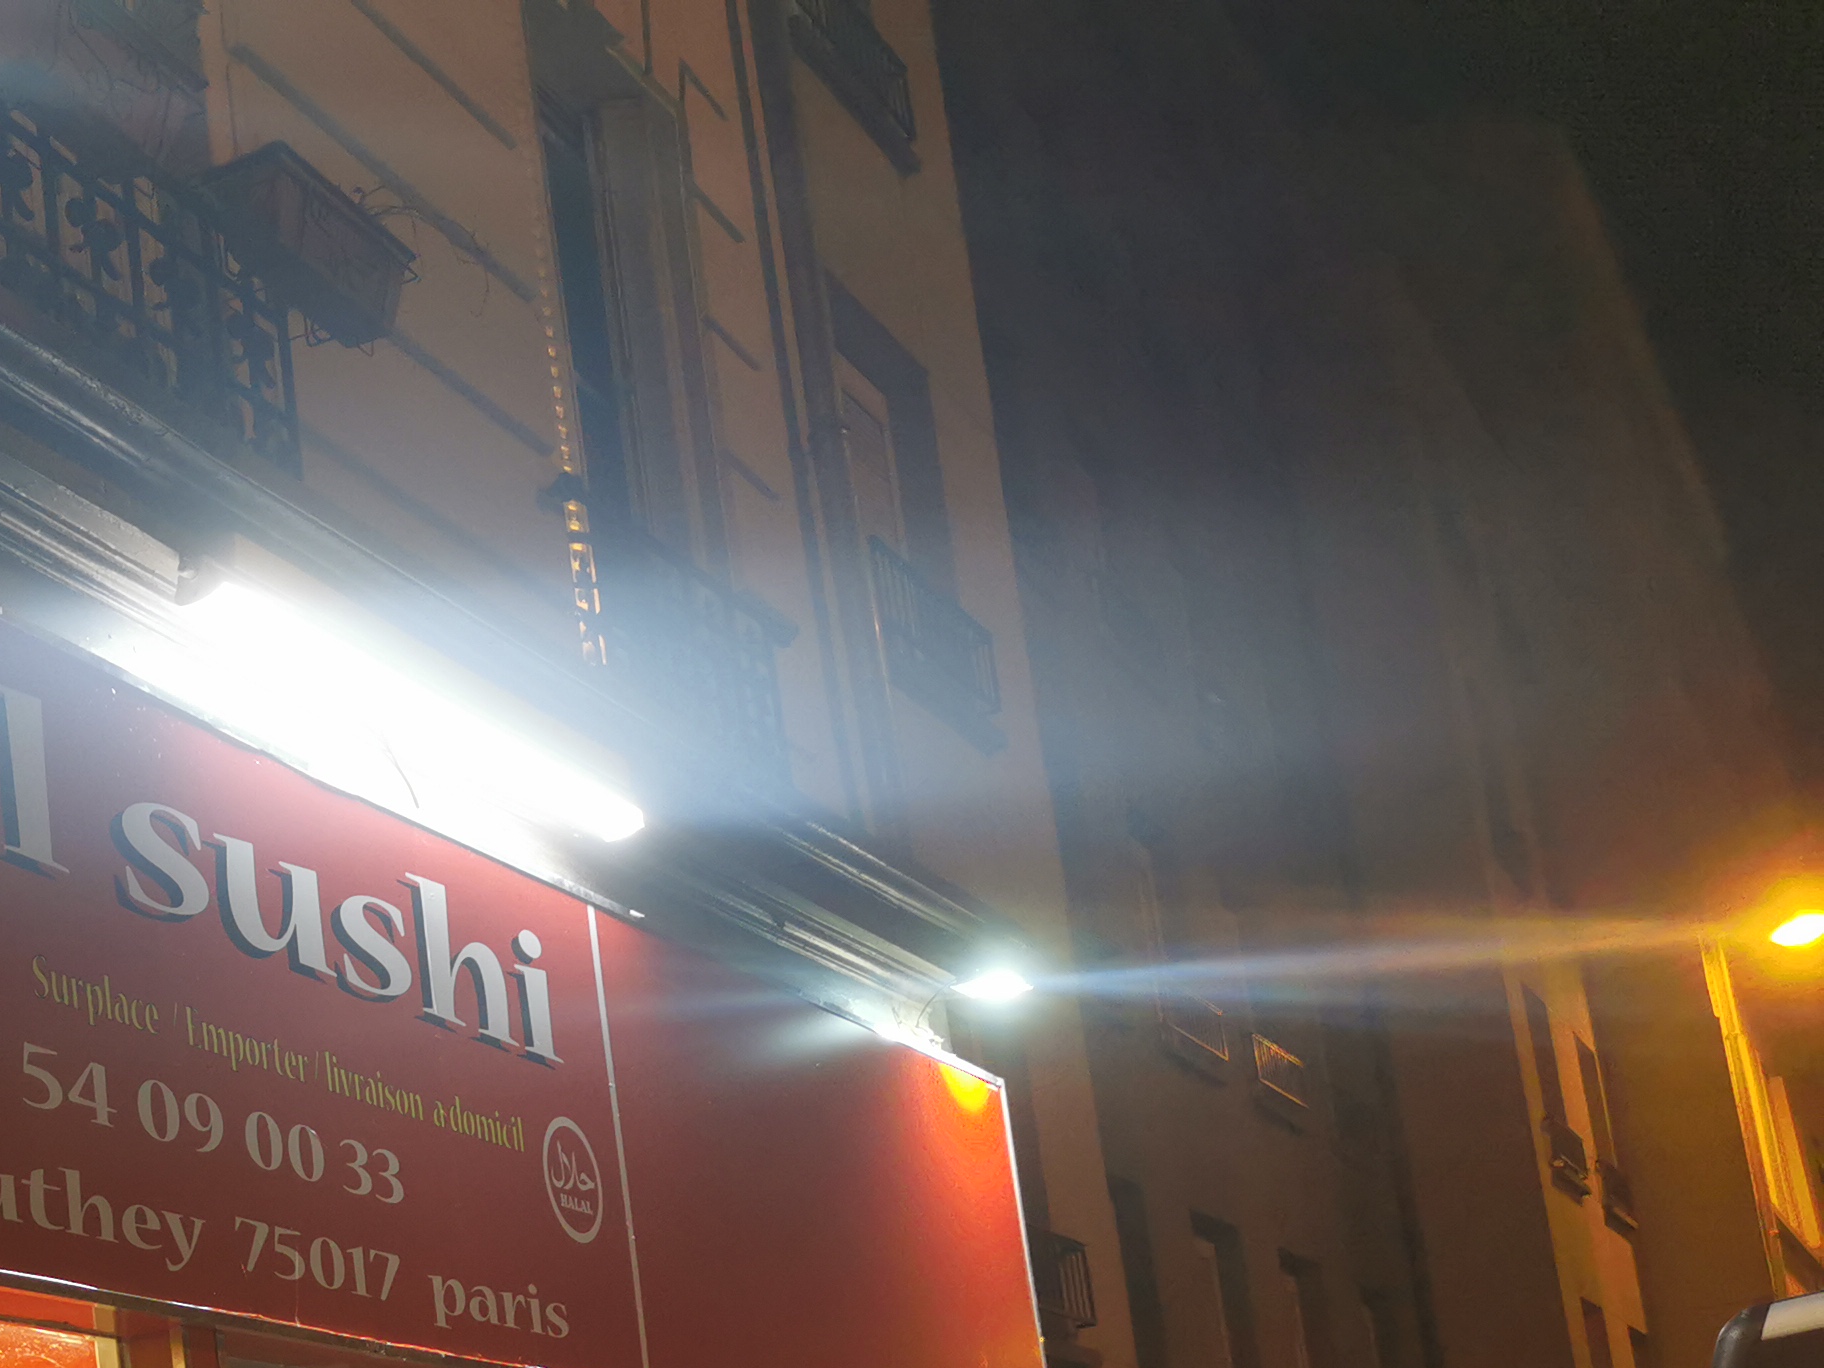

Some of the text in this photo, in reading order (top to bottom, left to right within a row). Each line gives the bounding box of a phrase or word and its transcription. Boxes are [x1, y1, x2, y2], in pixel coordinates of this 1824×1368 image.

[32, 954, 160, 1035] Surplace
[110, 801, 564, 1069] sushi
[22, 1041, 117, 1128] 54
[137, 1080, 224, 1153] 09
[245, 1111, 325, 1182] 00
[340, 1139, 405, 1204] 33
[560, 1193, 593, 1215] HALAL
[234, 1217, 401, 1301] 75017
[428, 1274, 570, 1339] paris
